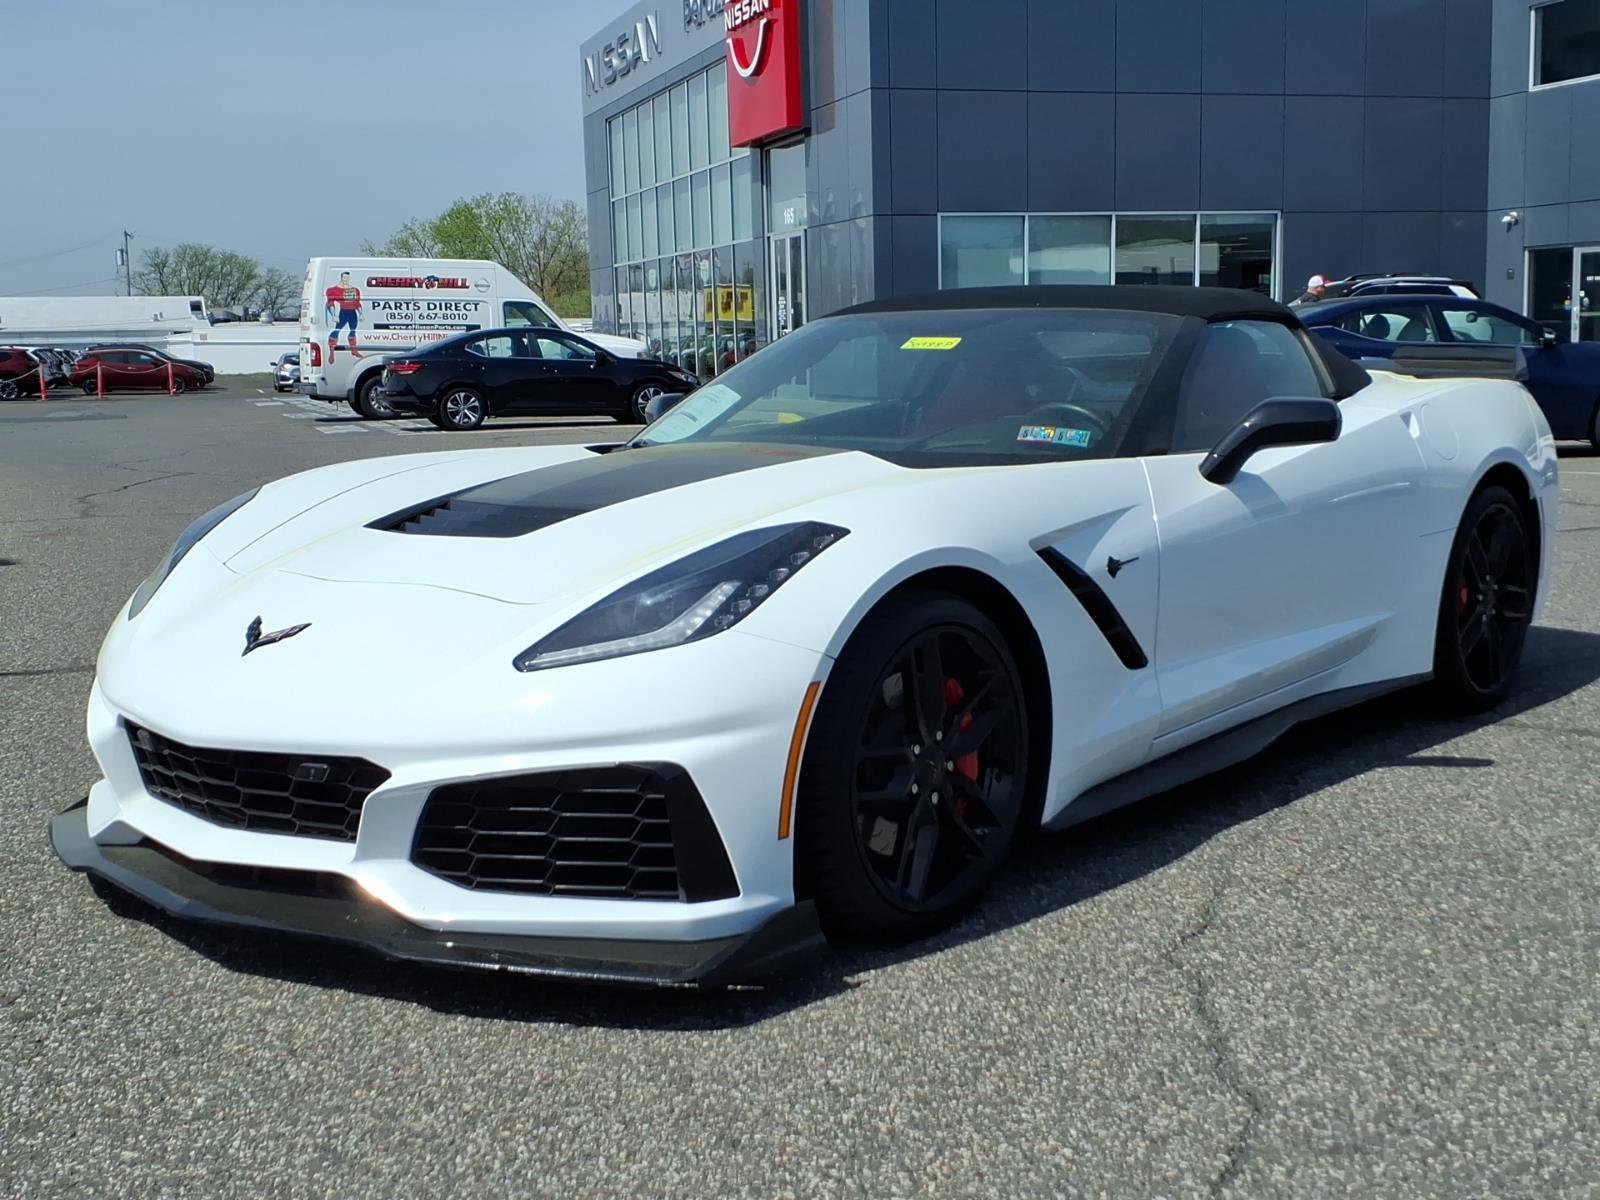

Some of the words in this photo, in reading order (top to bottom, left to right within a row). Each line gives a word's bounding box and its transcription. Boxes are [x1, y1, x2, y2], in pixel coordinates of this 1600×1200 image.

[584, 9, 663, 97] NISSAN
[783, 207, 795, 224] 165
[366, 276, 424, 289] CHERRY
[437, 277, 470, 289] HILL
[371, 301, 421, 311] PARTS
[427, 302, 480, 312] DIRECT
[385, 312, 414, 321] (856)
[418, 312, 468, 321] 667-8010
